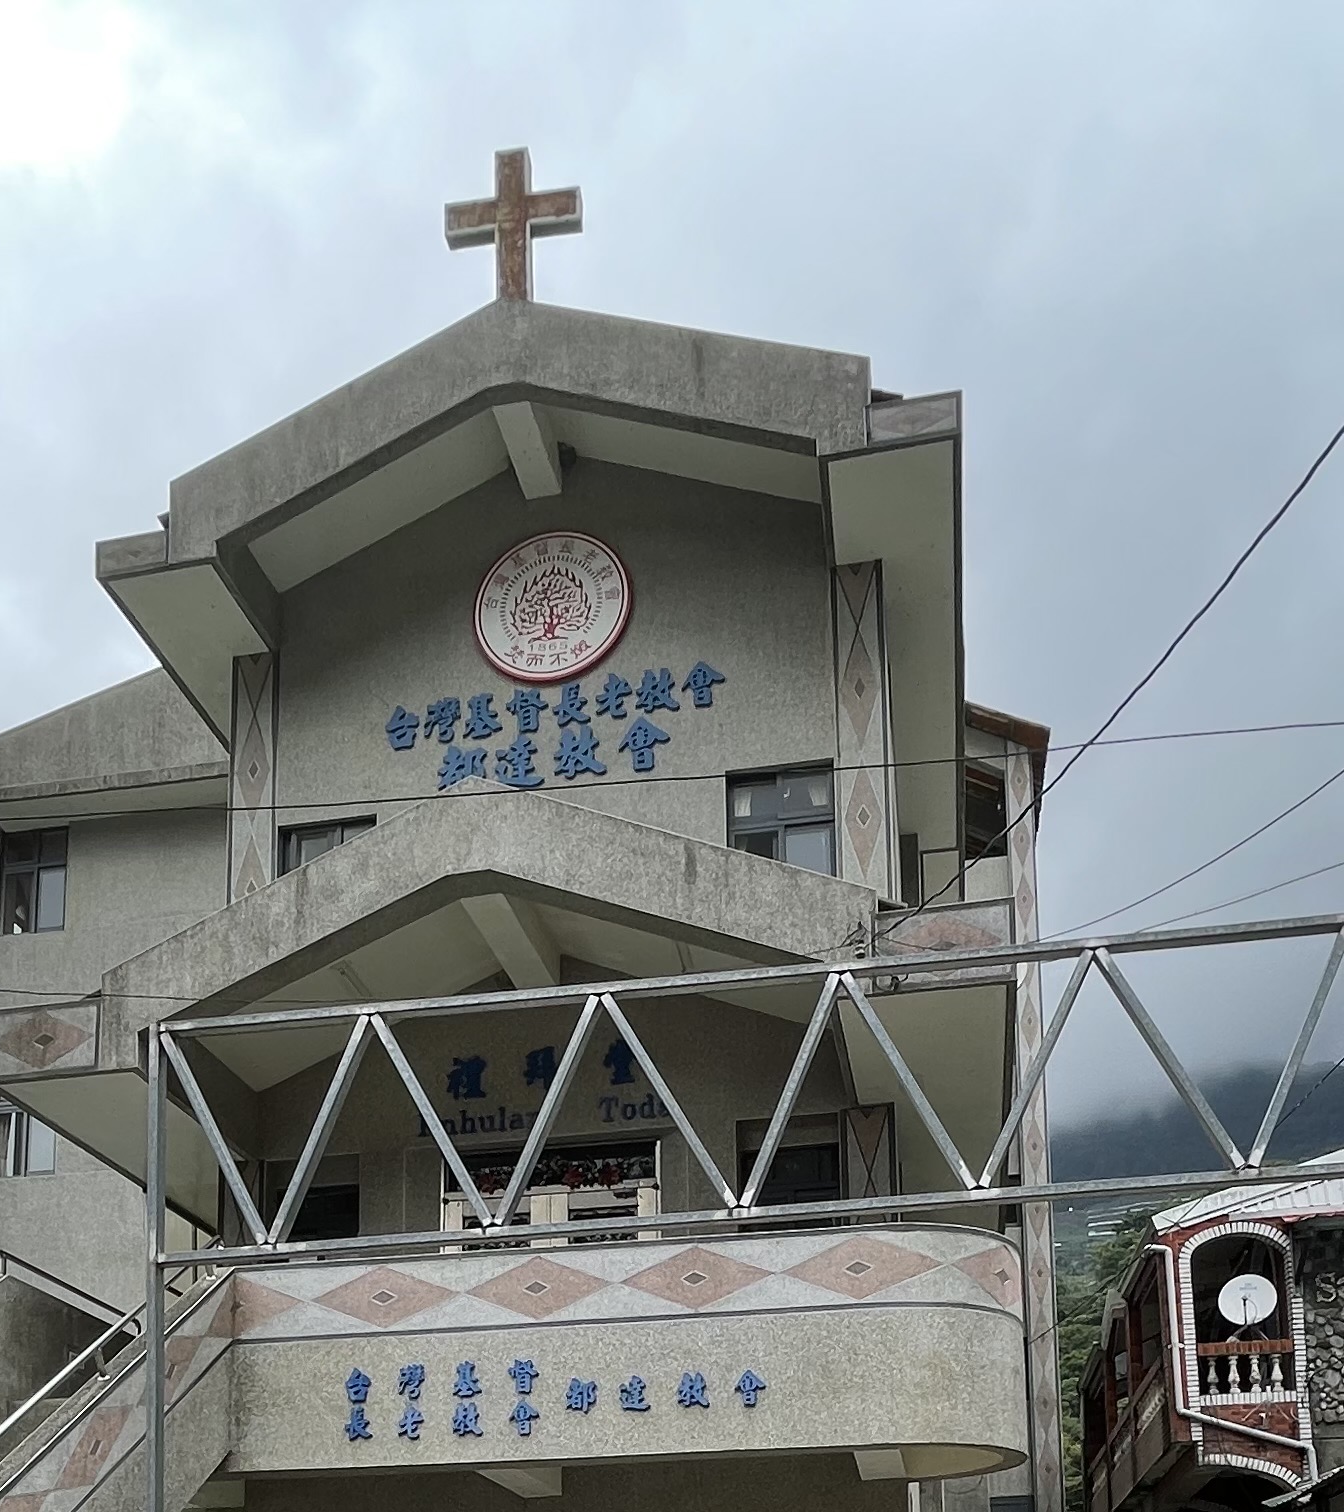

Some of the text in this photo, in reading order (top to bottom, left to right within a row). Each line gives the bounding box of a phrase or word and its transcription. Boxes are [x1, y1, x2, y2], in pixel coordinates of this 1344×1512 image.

[529, 643, 568, 652] 1865
[385, 661, 725, 750] 台灣基督長老教會
[437, 716, 670, 790] 都達教會
[417, 1105, 540, 1137] nhula
[344, 1358, 540, 1402] 台灣基督
[566, 1369, 766, 1415] 都達教會
[344, 1399, 540, 1442] 長老教會
